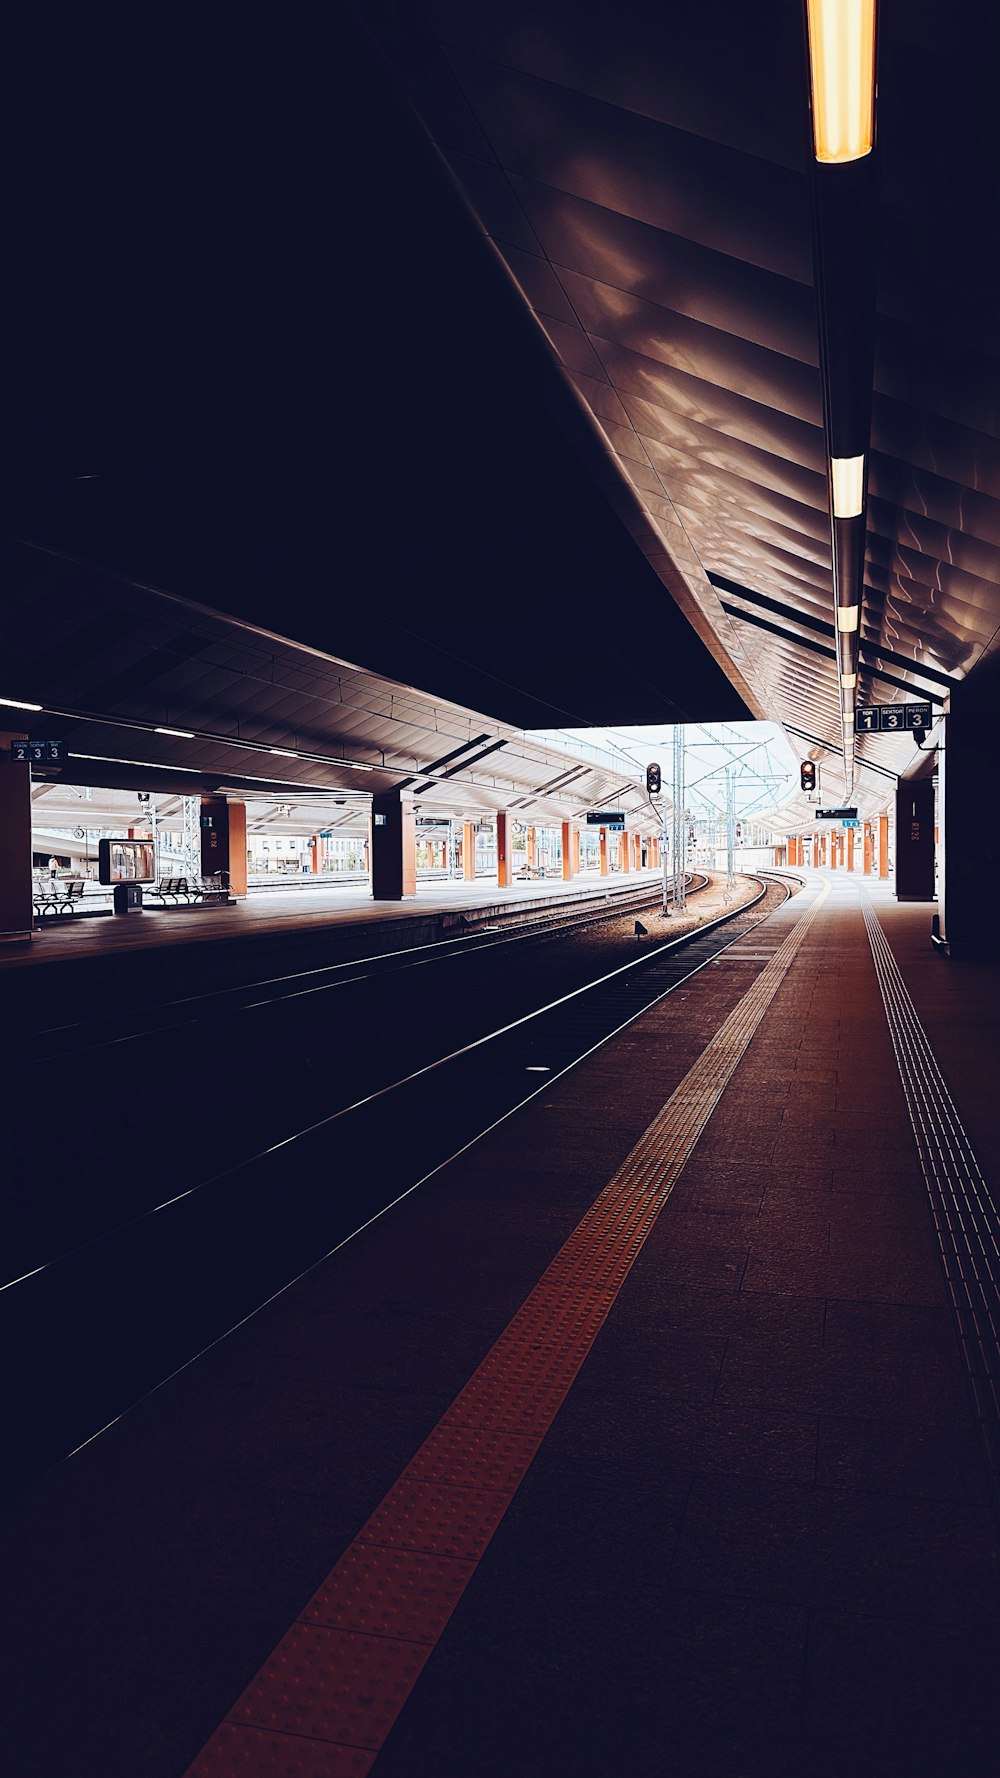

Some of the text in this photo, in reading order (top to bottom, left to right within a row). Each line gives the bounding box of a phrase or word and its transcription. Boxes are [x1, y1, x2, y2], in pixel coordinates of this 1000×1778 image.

[864, 714, 922, 728] 1 3 3
[17, 747, 59, 759] 2 3 3
